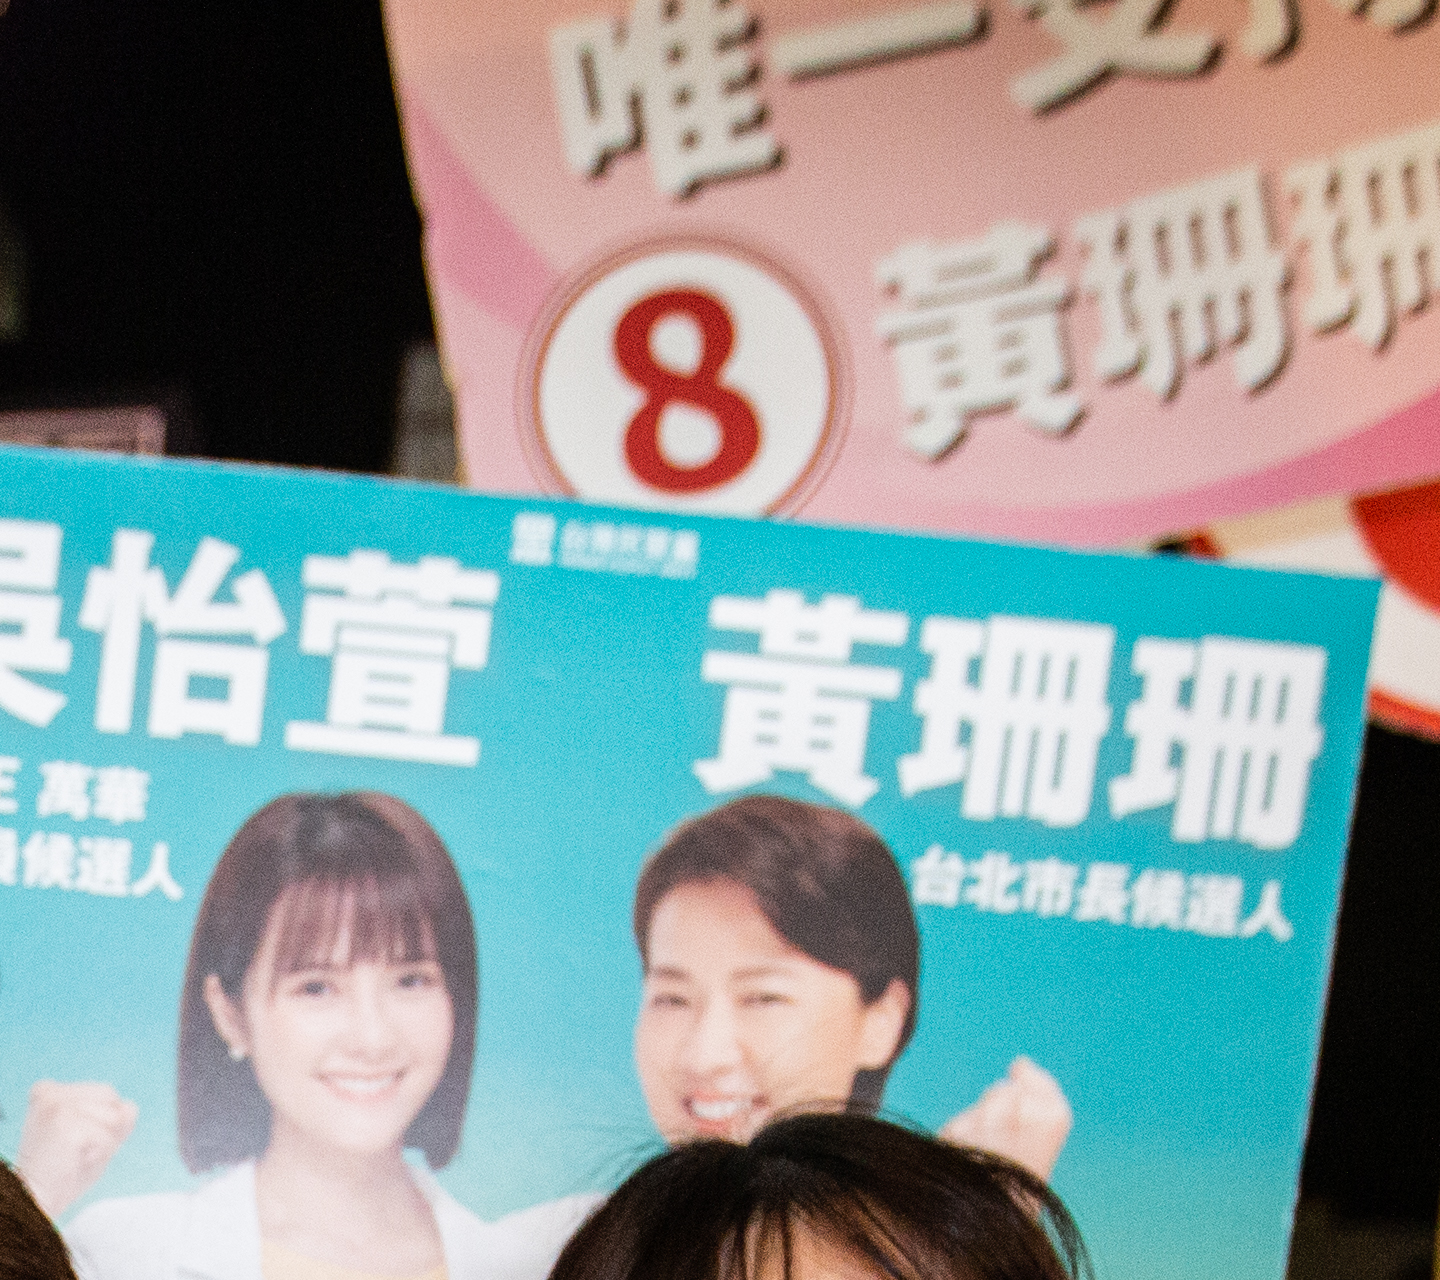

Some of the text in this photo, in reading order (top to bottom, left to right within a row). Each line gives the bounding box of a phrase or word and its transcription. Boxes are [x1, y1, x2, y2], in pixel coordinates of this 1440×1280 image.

[612, 286, 764, 494] 8
[35, 759, 151, 825] 萬華
[692, 588, 1330, 854] 黃珊珊
[911, 843, 1295, 942] 台北市長候選人
